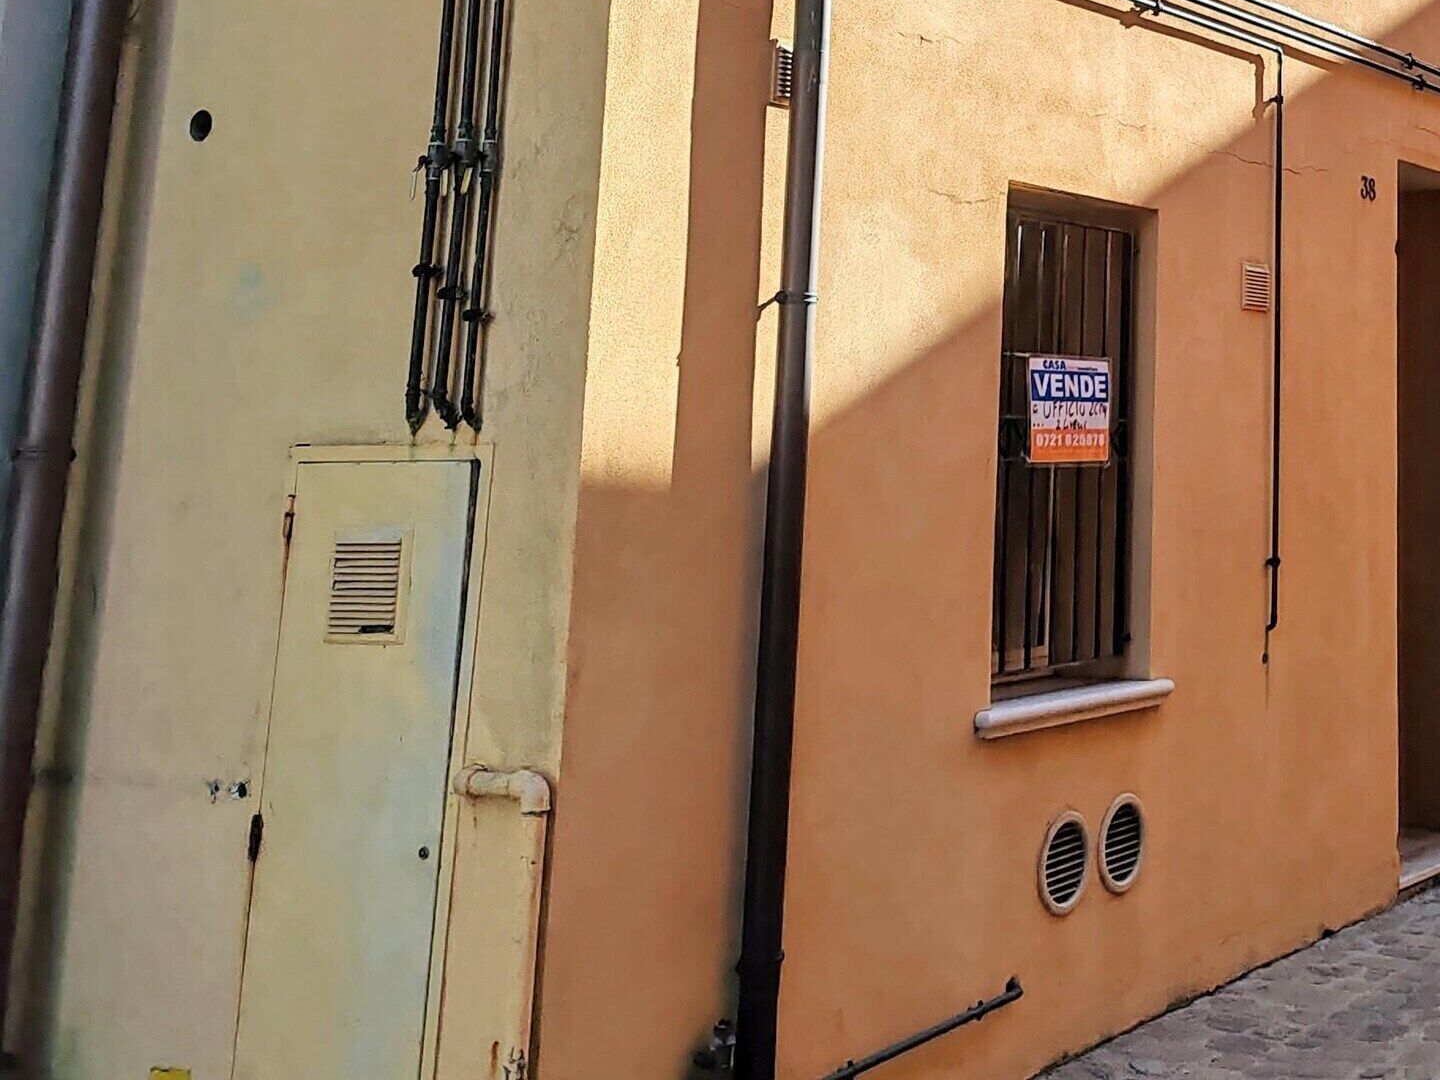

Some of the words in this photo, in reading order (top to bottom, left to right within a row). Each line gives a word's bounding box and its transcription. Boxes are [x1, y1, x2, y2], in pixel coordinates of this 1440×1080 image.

[1361, 175, 1376, 202] 38
[1043, 360, 1066, 370] CASA
[1033, 373, 1107, 398] VENDE
